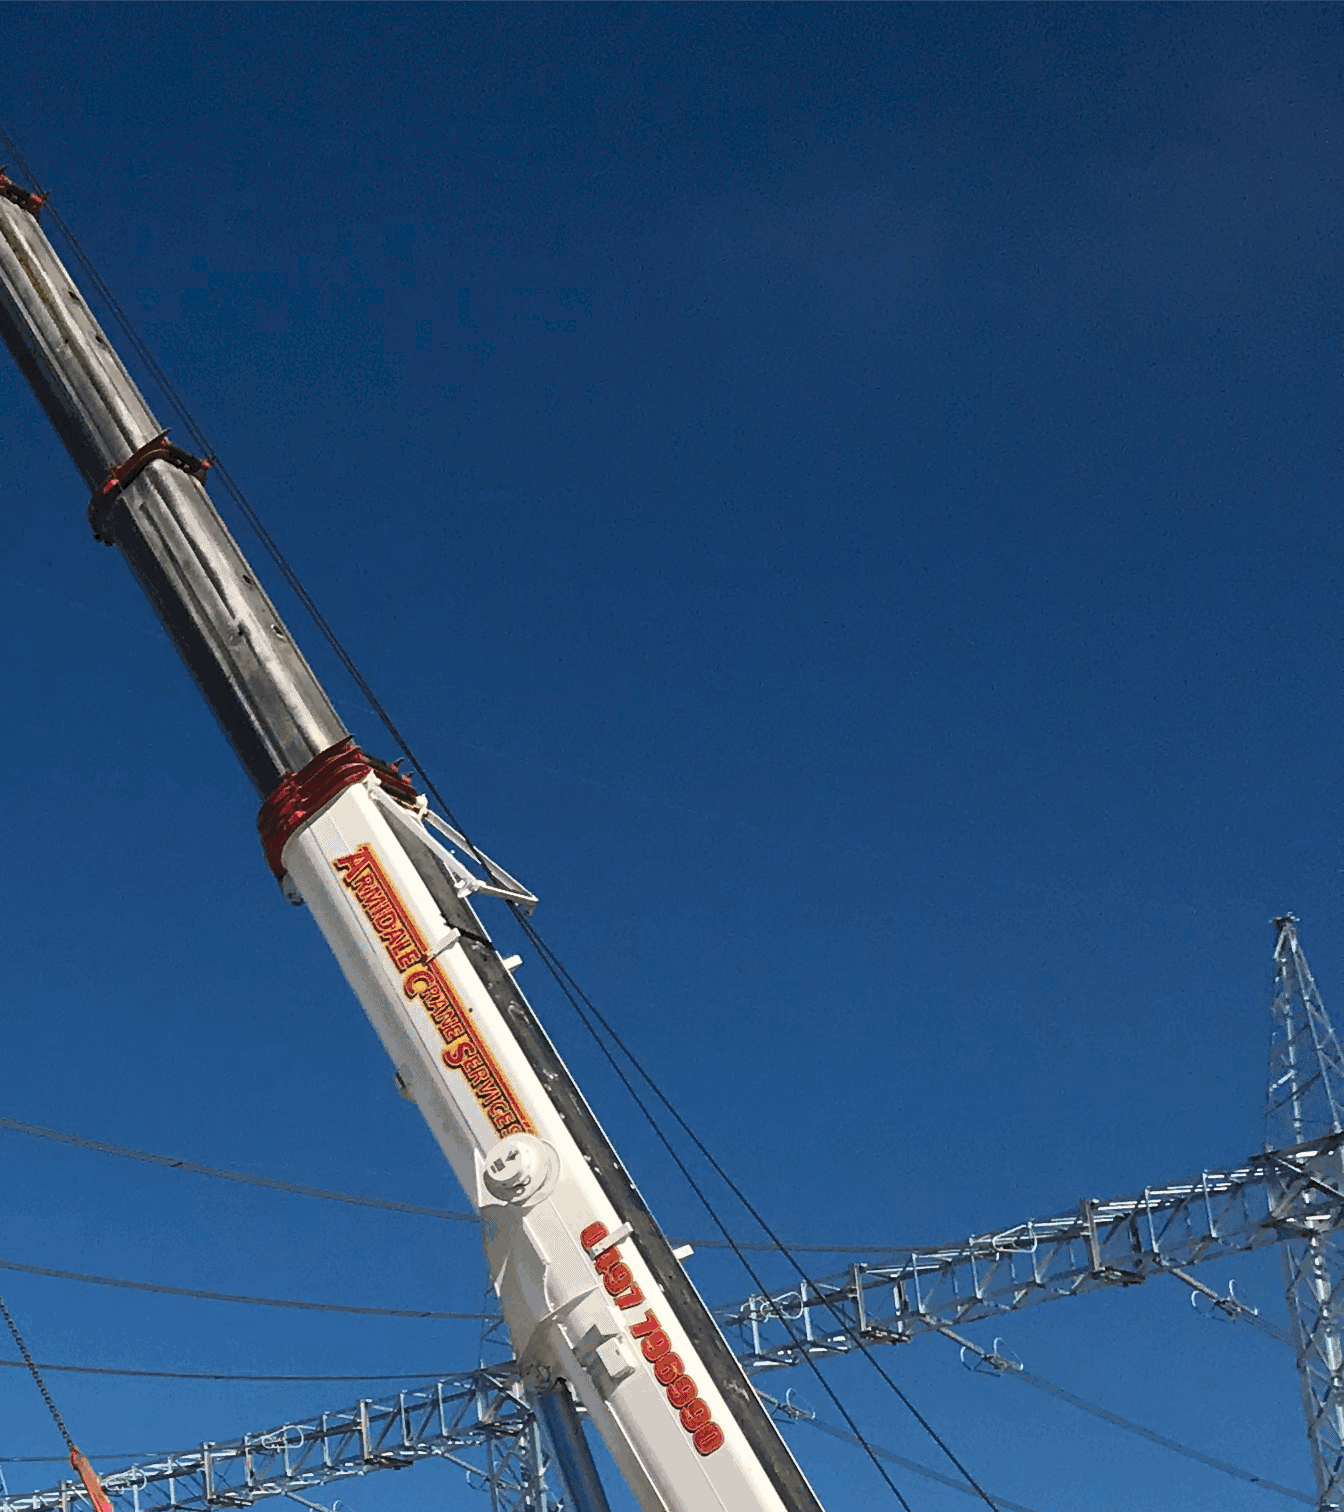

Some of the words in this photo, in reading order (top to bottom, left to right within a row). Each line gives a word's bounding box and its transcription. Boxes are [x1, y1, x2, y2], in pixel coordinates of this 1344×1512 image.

[333, 846, 422, 974] ARMIDALE
[403, 969, 465, 1045] CRANE
[629, 1308, 724, 1456] 796990
